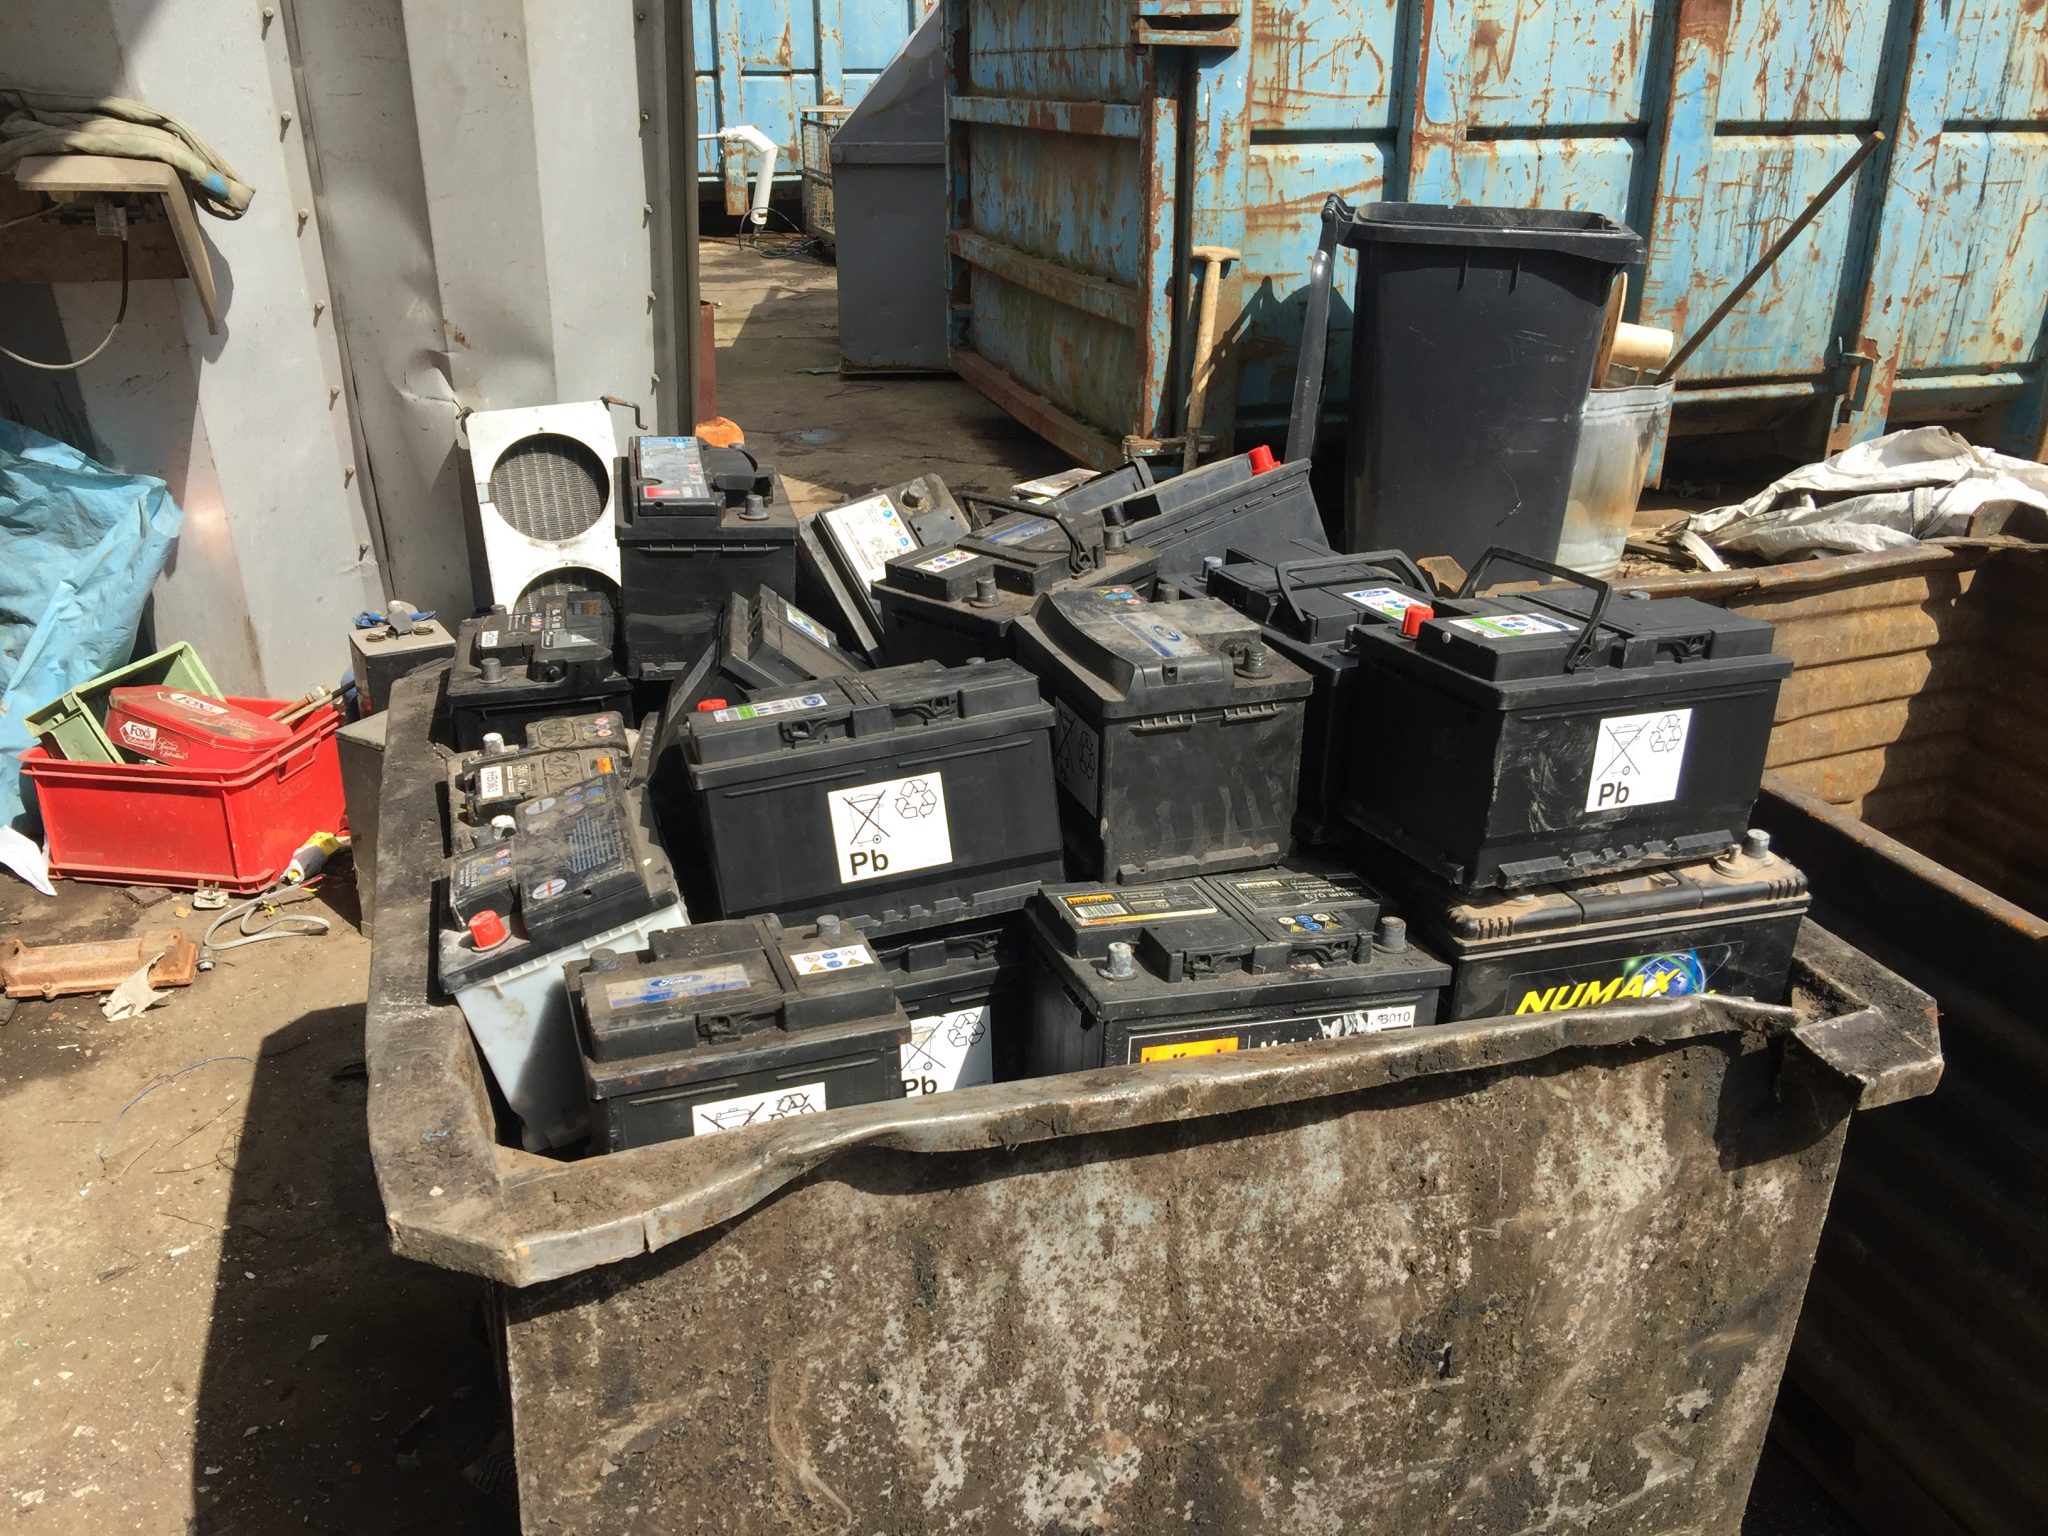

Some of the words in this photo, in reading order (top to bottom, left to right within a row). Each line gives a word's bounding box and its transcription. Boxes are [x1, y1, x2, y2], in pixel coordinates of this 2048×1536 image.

[1597, 780, 1630, 807] Pb
[849, 849, 889, 876] Pb
[658, 975, 694, 987] Ford
[1515, 968, 1681, 1016] NUMAX
[901, 1076, 938, 1098] Pb
